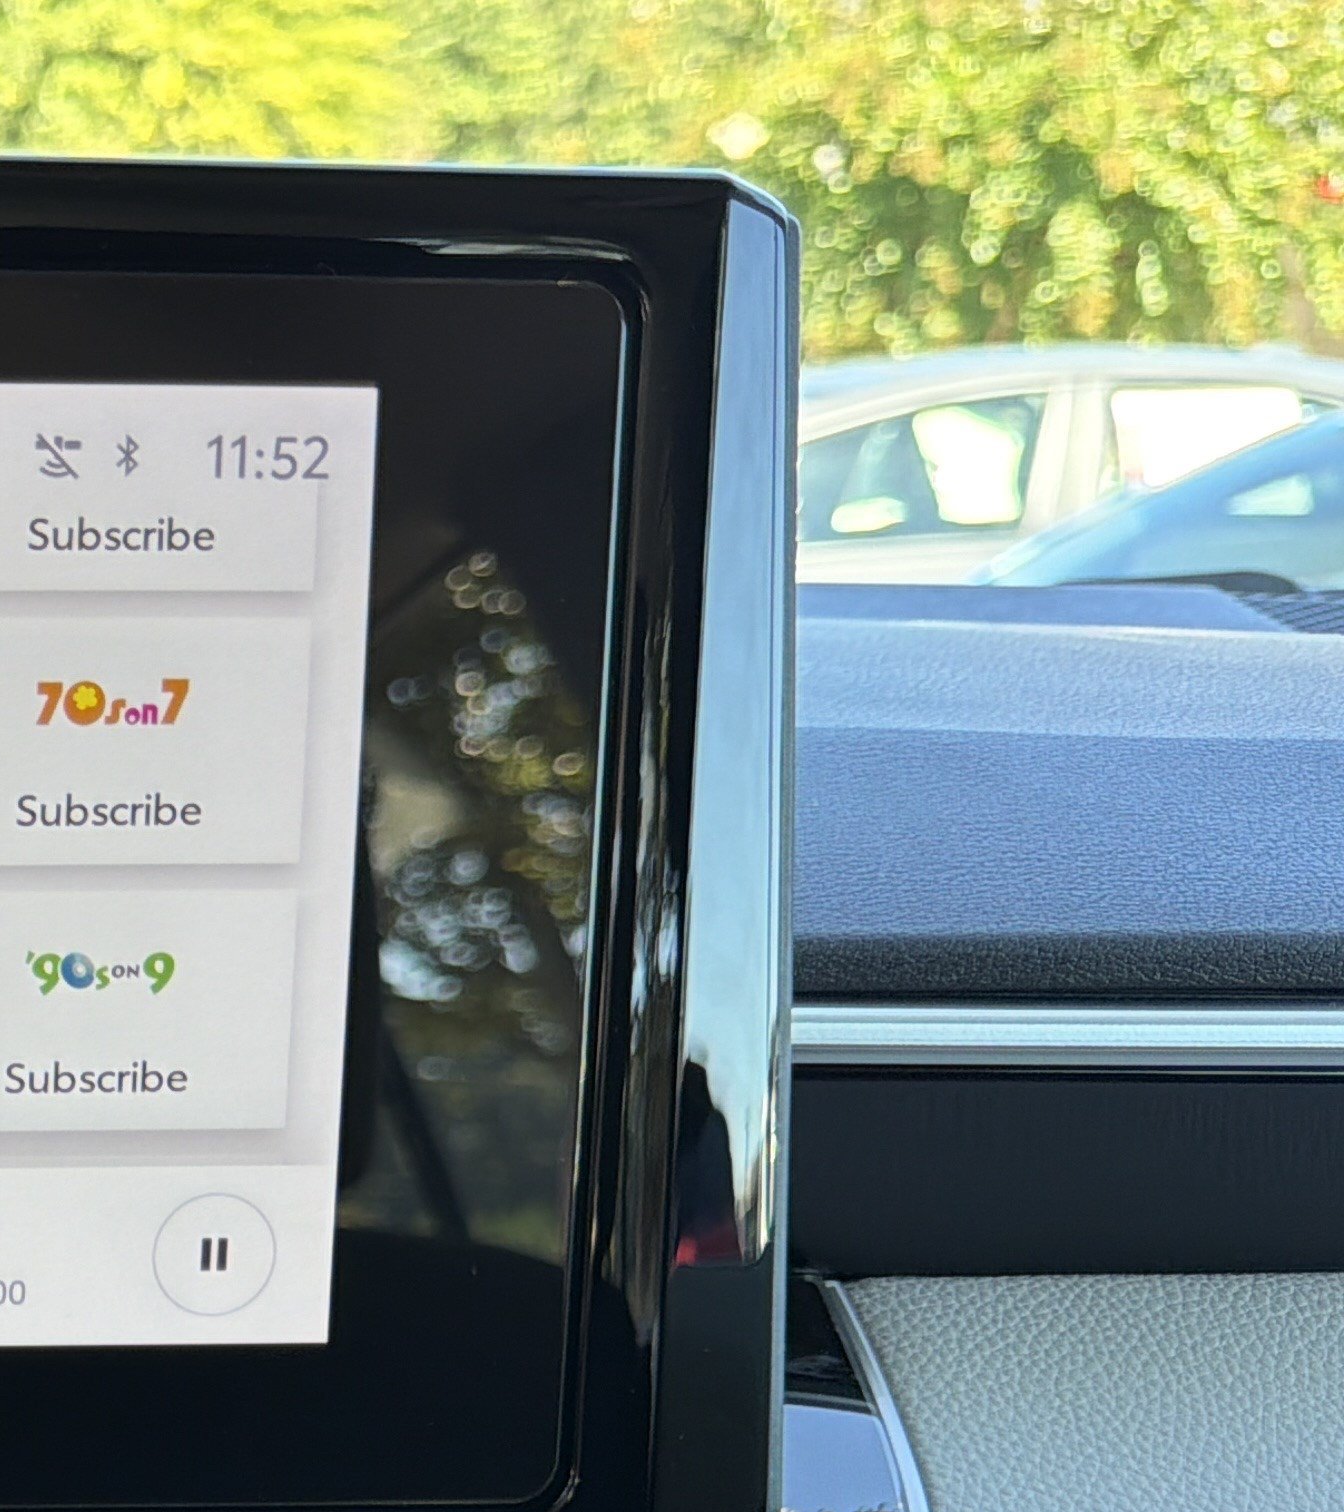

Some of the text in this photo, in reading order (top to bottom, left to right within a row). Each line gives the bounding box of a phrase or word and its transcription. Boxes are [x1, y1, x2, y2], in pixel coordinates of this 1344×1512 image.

[208, 434, 330, 480] 11:52
[28, 516, 215, 552] Subscribe
[16, 792, 202, 827] Subscribe
[4, 1060, 188, 1094] Subscribe
